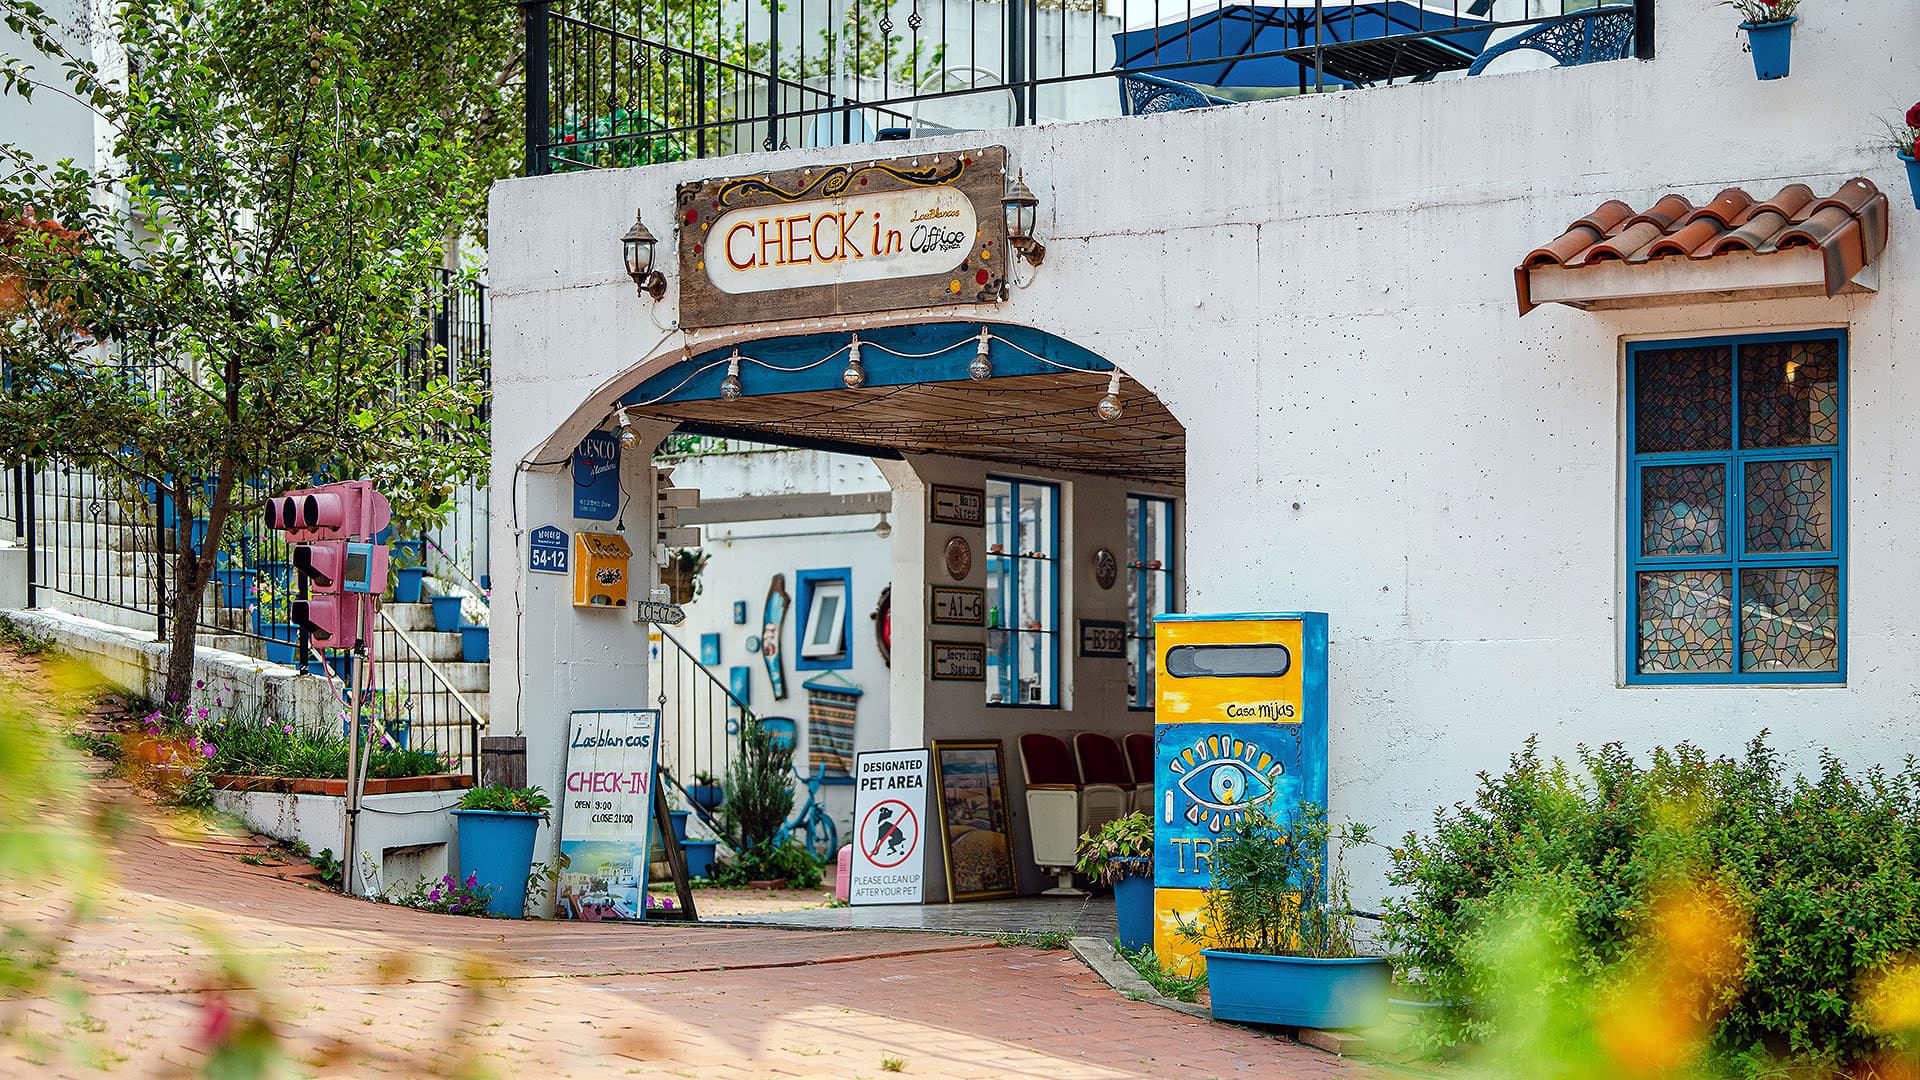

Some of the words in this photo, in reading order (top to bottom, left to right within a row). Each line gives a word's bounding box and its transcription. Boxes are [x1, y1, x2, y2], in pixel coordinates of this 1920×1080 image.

[725, 209, 865, 272] CHECK
[870, 212, 903, 257] in
[910, 225, 965, 253] Office
[579, 439, 615, 461] CESCO
[593, 538, 619, 552] Post
[532, 549, 565, 568] 54-12
[1226, 704, 1256, 718] Casa
[863, 759, 922, 772] DESIGNATED
[567, 771, 649, 795] CHECK-IN
[861, 777, 884, 791] PET
[887, 775, 923, 790] AREA
[574, 801, 591, 809] OPEN
[595, 801, 612, 810] 9:00
[592, 814, 614, 824] CLOSE
[614, 814, 634, 825] 21:00
[854, 876, 882, 886] PLEASE
[882, 875, 909, 885] CLEAN
[910, 874, 920, 884] UP
[855, 887, 880, 897] AFTER
[880, 887, 902, 896] YOUR
[903, 886, 917, 895] PET
